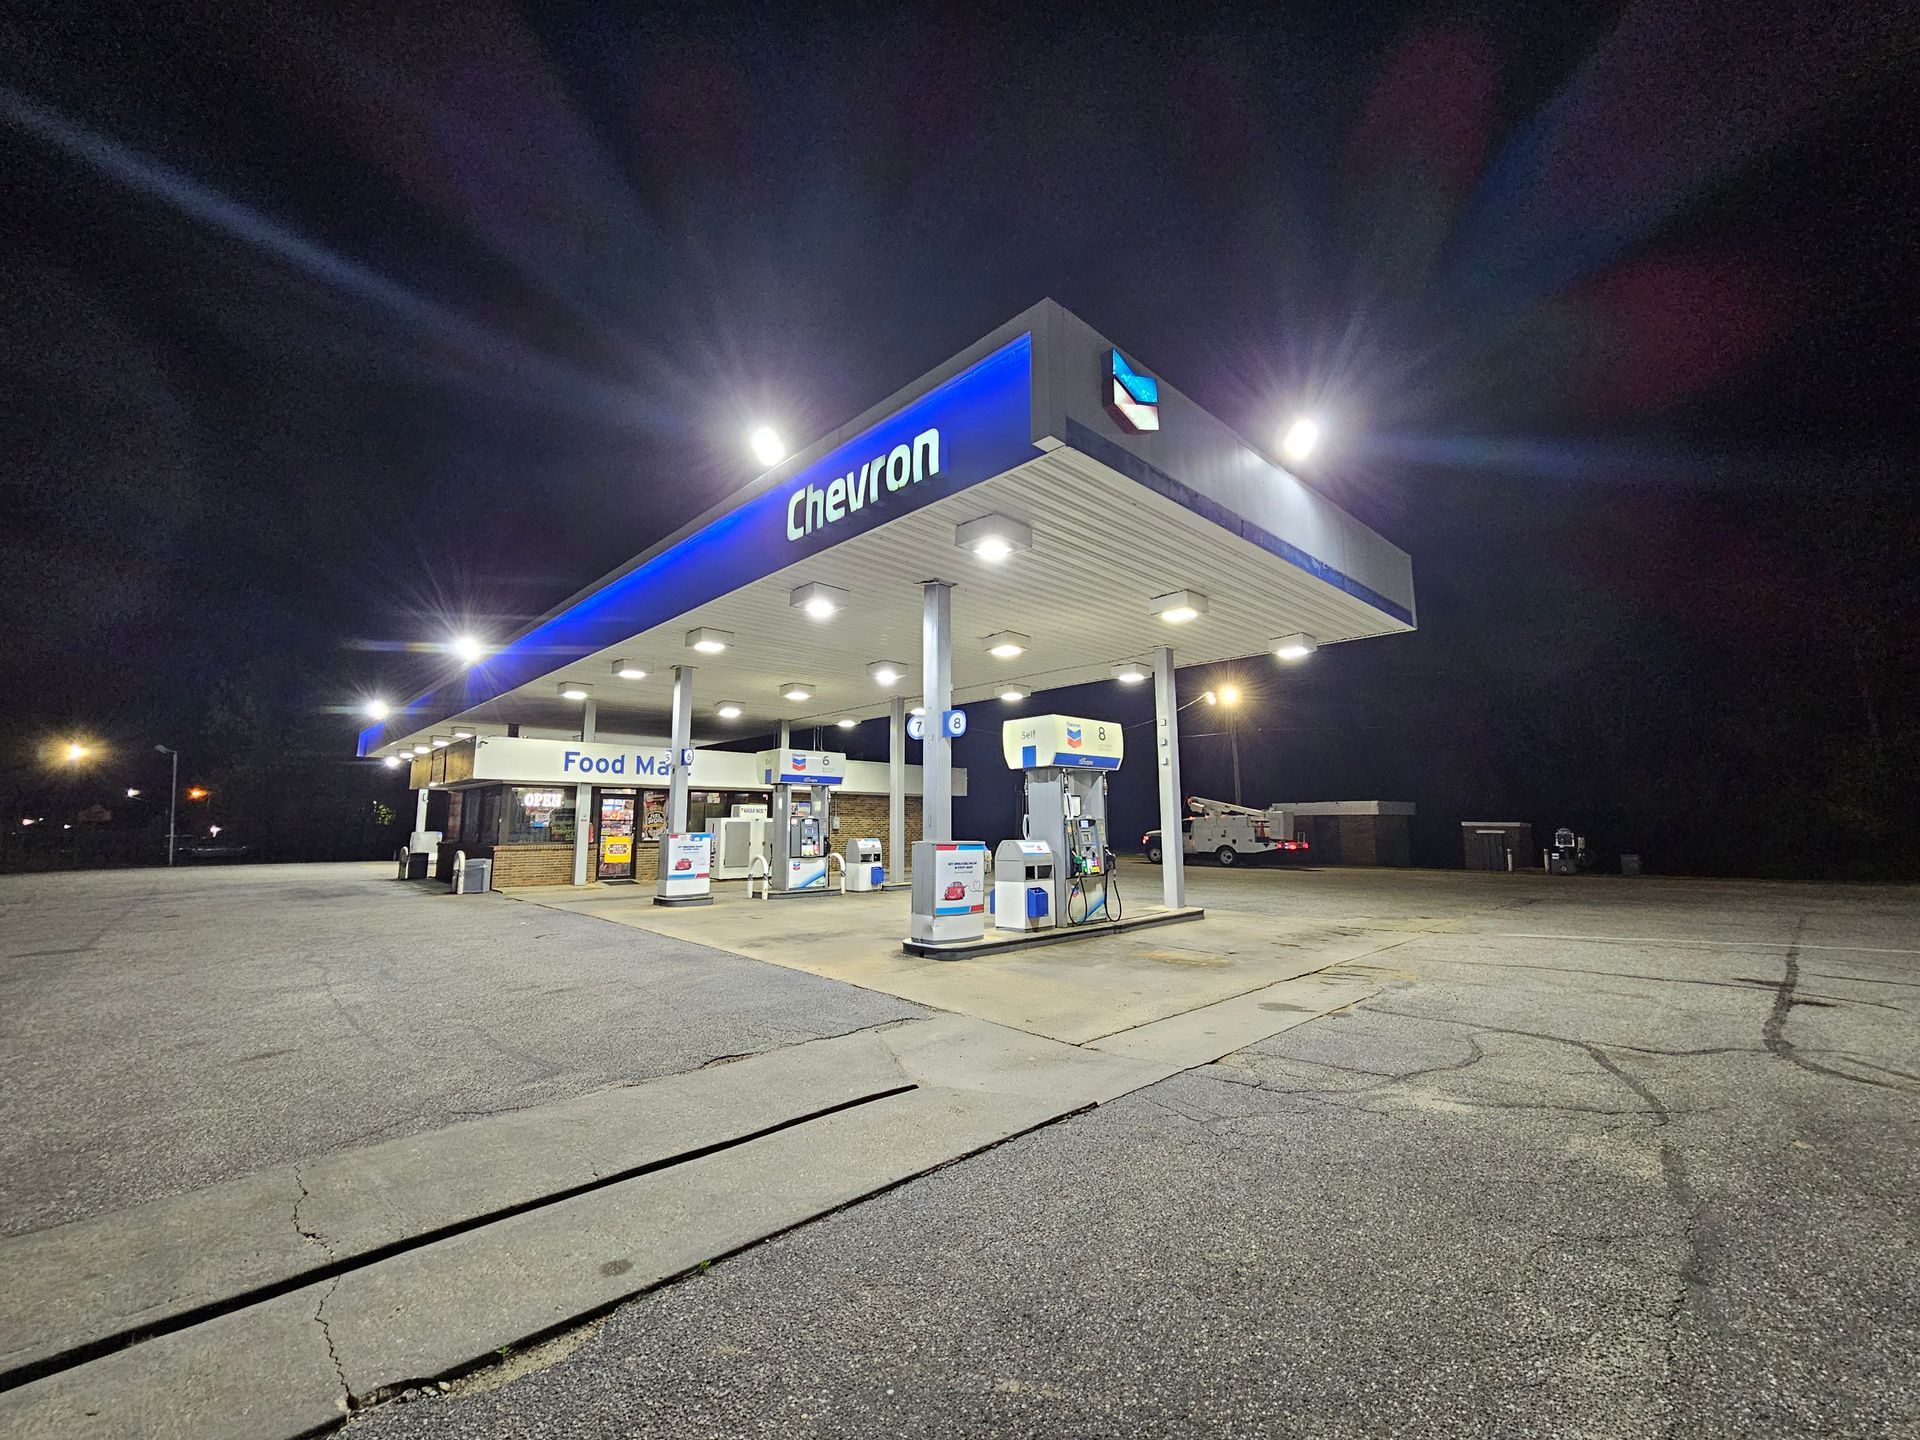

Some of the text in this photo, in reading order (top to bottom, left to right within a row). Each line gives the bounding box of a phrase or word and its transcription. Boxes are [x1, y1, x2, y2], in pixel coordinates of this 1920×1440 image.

[787, 428, 939, 541] Chevron
[915, 721, 923, 732] 7
[953, 717, 961, 729] 8
[1021, 729, 1036, 740] Self
[1098, 726, 1106, 741] 8
[563, 751, 691, 776] Food Ma
[822, 755, 830, 766] 6
[523, 793, 562, 807] OPEN
